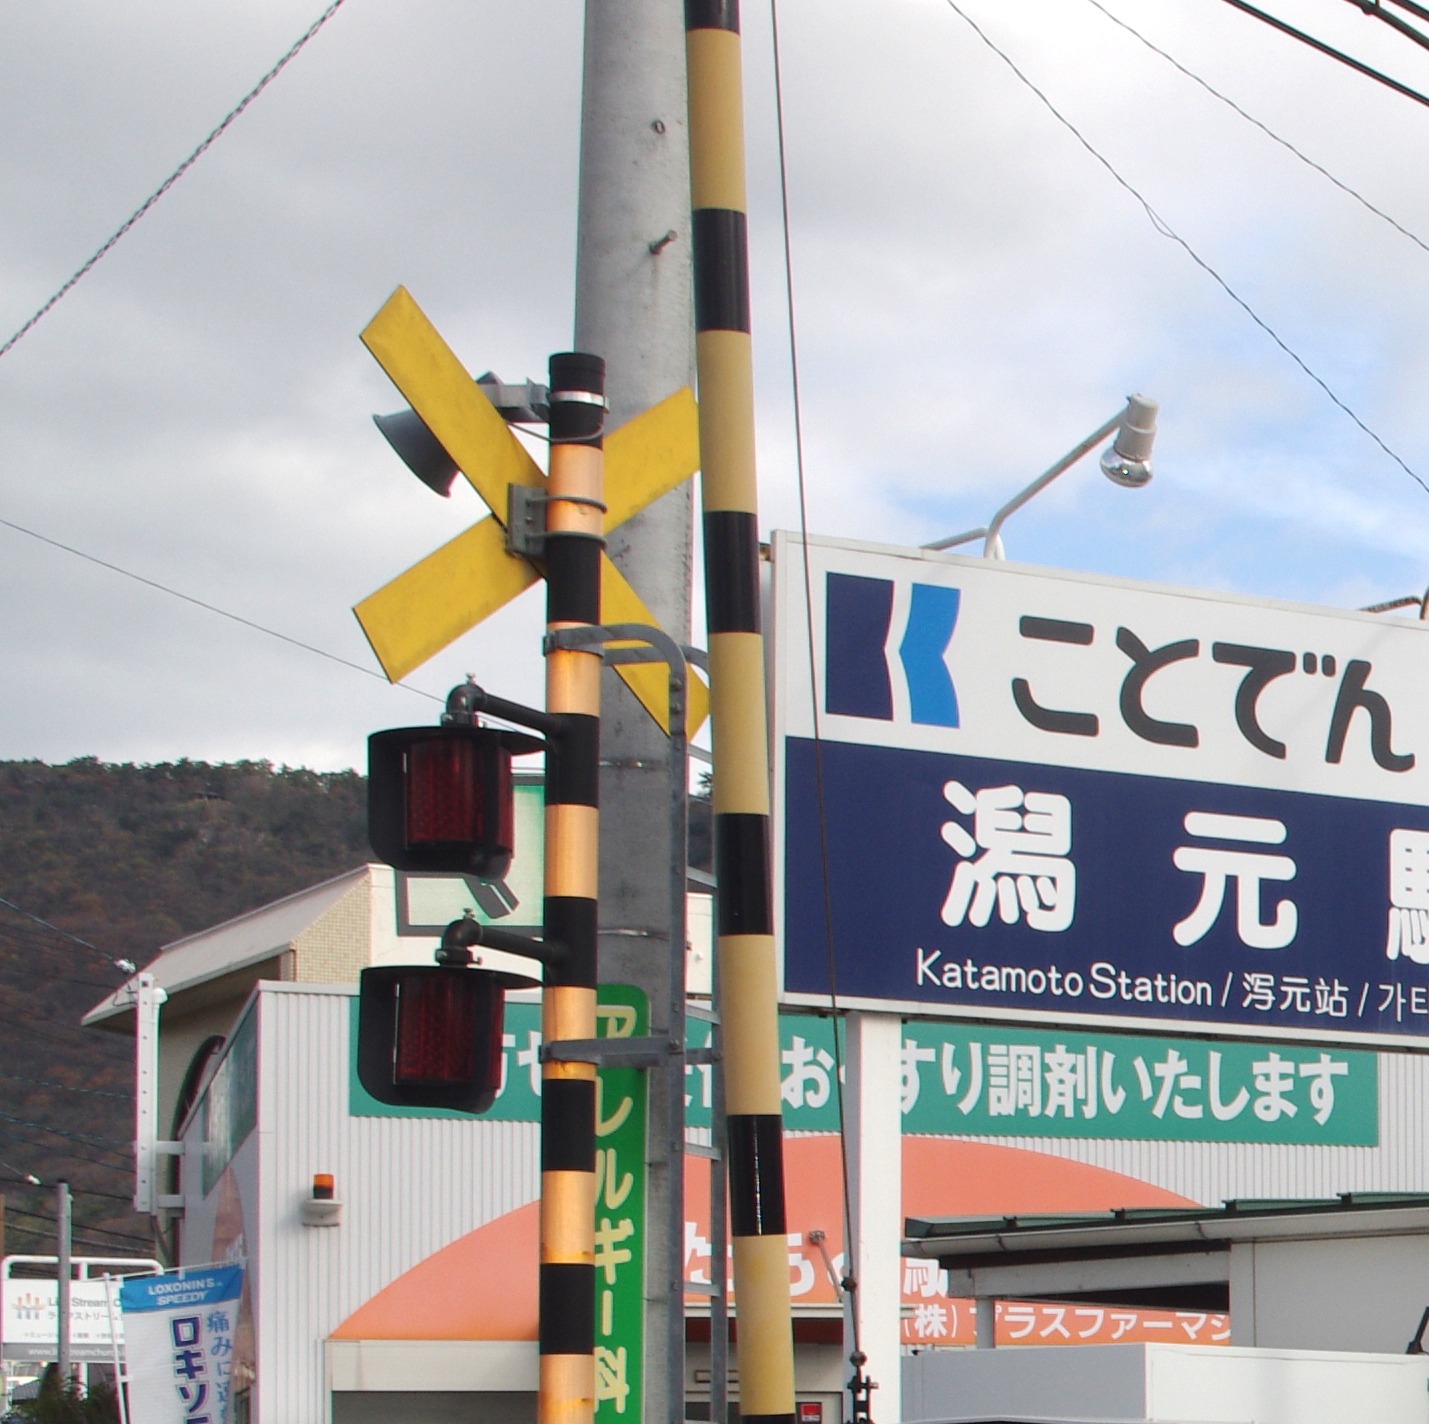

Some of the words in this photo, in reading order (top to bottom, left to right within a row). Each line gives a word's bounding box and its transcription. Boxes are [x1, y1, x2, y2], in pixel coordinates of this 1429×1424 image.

[1012, 615, 1416, 774] ことでん
[916, 947, 1084, 997] Katamoto
[1089, 961, 1213, 1006] Station
[1242, 971, 1349, 1018] 泻元站
[781, 1034, 1349, 1127] おすり調剤いたします
[156, 1290, 208, 1306] SPEEDY
